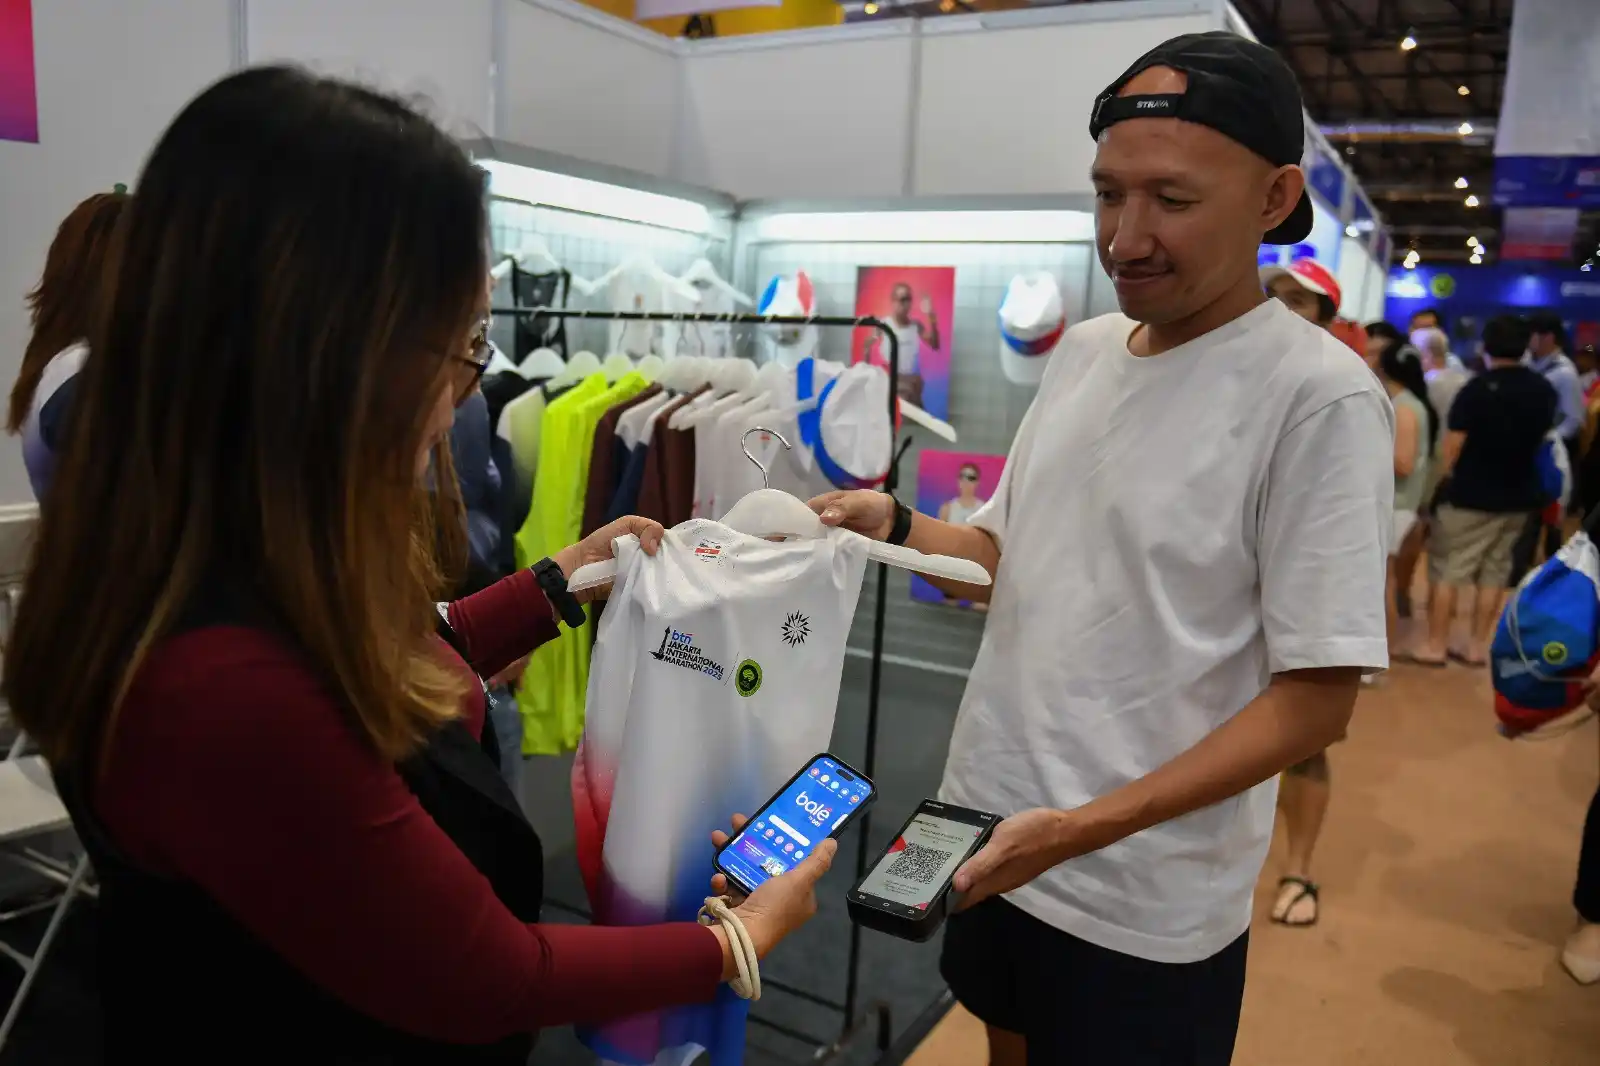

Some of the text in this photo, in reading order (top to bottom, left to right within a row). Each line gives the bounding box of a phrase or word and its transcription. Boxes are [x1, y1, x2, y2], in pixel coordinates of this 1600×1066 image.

[1136, 100, 1169, 109] STRAVA
[672, 629, 693, 645] btn
[667, 641, 702, 655] JAKARTA
[663, 655, 724, 681] MARATHON 2025
[665, 648, 724, 675] INTERNATIONAL
